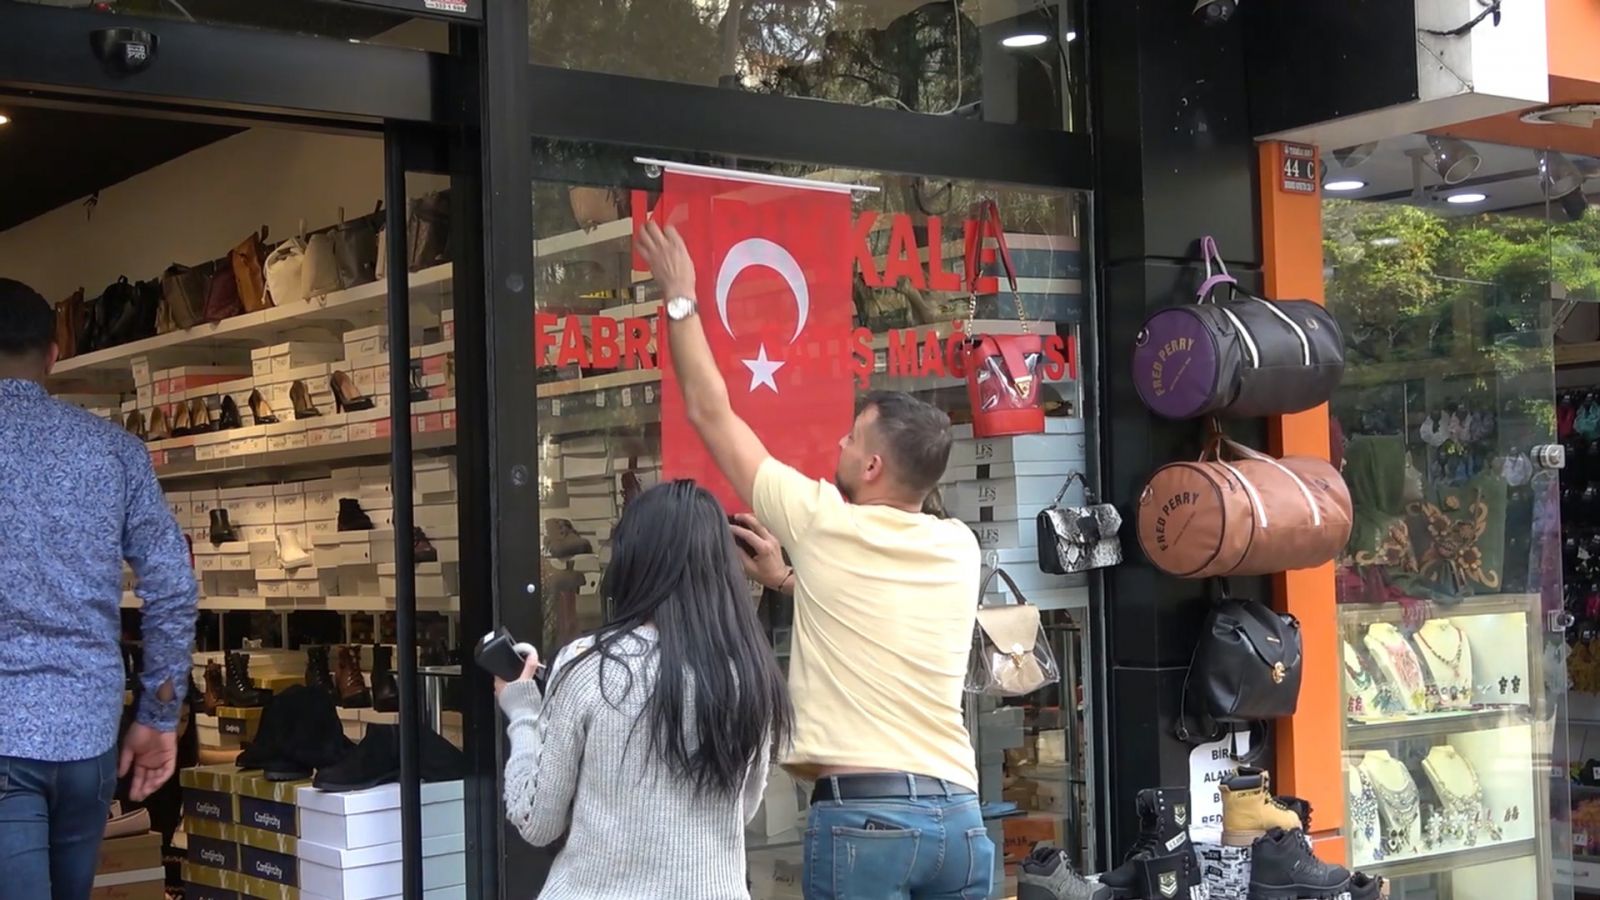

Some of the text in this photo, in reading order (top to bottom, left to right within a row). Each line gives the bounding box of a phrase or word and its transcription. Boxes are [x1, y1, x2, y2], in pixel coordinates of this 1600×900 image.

[1284, 158, 1314, 179] 44 C
[888, 319, 1077, 381] MAĞSI
[1158, 337, 1195, 361] PERRY
[1152, 361, 1165, 396] FRED
[1155, 516, 1169, 551] FRED
[1162, 491, 1199, 516] PERRY
[1211, 746, 1229, 760] BİR
